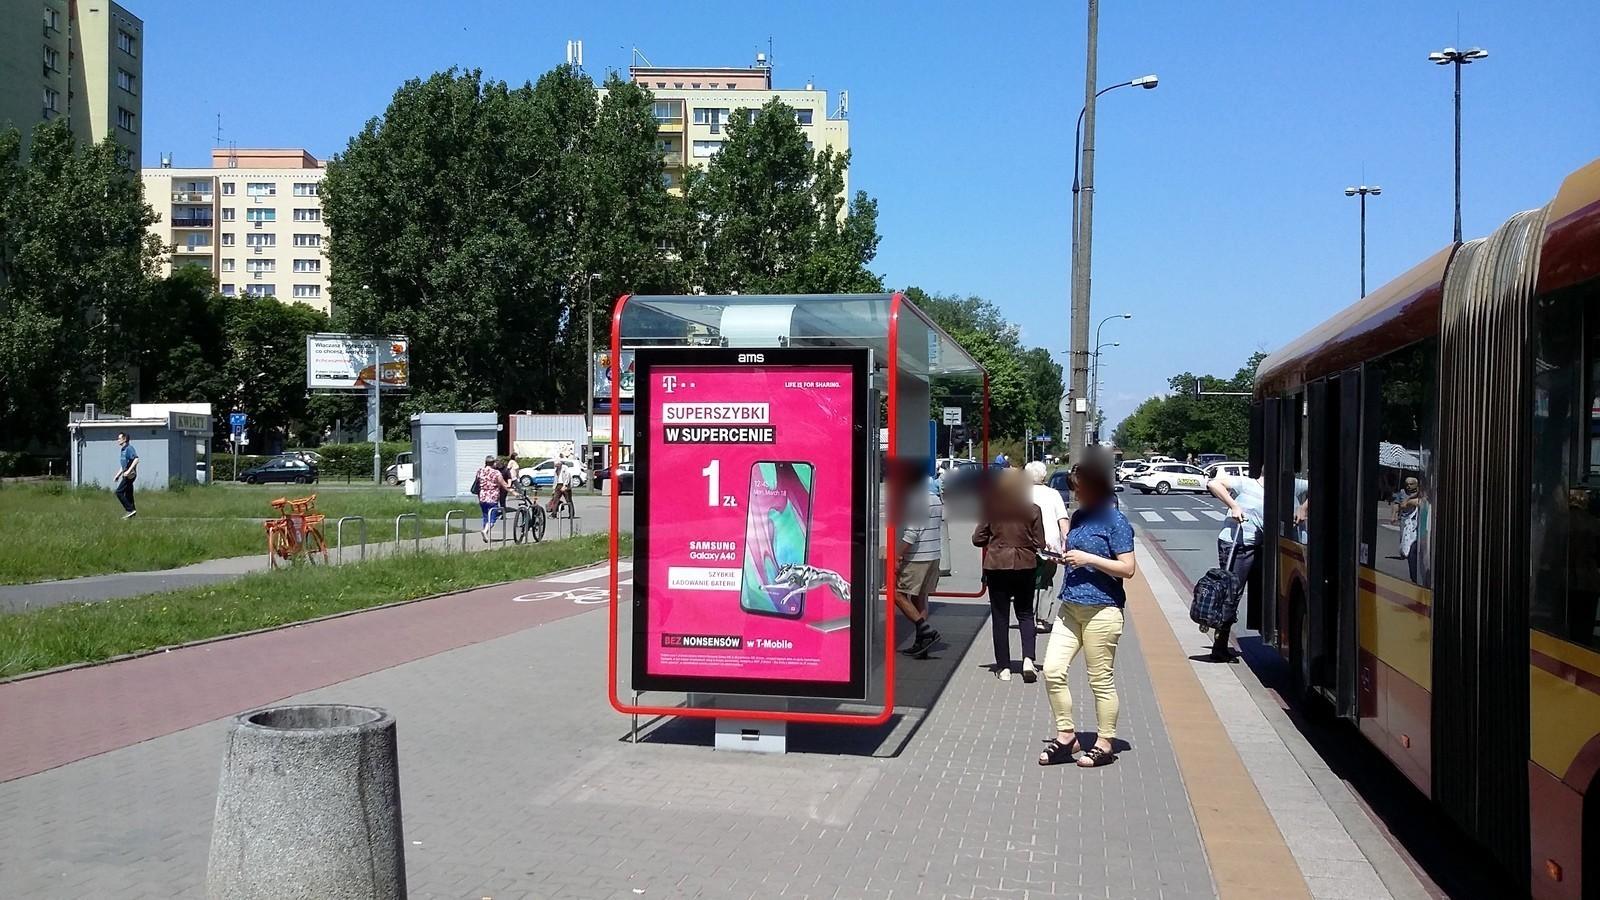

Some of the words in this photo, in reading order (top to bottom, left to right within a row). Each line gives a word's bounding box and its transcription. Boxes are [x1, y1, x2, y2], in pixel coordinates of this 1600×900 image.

[738, 353, 765, 363] ams
[666, 406, 766, 420] SUPERSZYBKI
[178, 415, 206, 429] KWIATY
[666, 428, 680, 442] W
[683, 428, 773, 442] SUPERCENIE
[702, 459, 720, 507] 1
[689, 541, 736, 551] SAMSUNG
[689, 551, 719, 562] Galaxy
[719, 552, 736, 561] A40
[664, 636, 682, 646] BEZ
[682, 635, 740, 648] NONSENSÓW
[746, 640, 755, 648] w
[756, 639, 793, 649] T-Mobile
